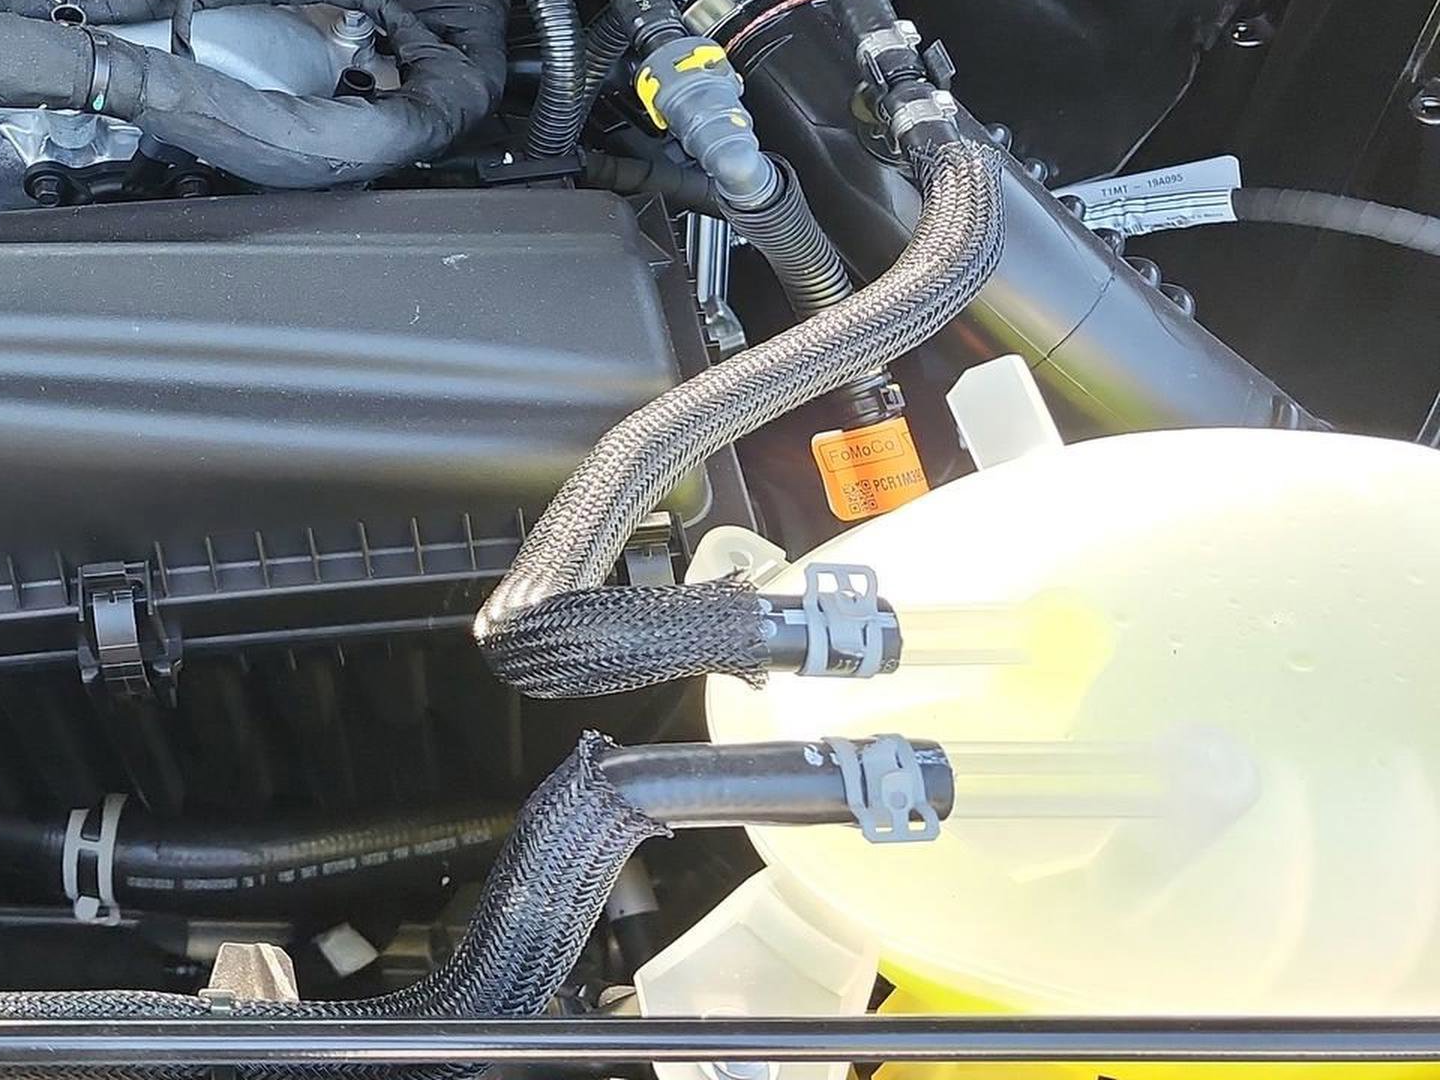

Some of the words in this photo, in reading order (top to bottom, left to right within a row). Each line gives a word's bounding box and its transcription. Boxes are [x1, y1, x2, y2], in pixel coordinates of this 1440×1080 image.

[1100, 184, 1129, 198] T1MT
[1146, 173, 1184, 189] 19A095
[828, 439, 896, 465] FoMoCo
